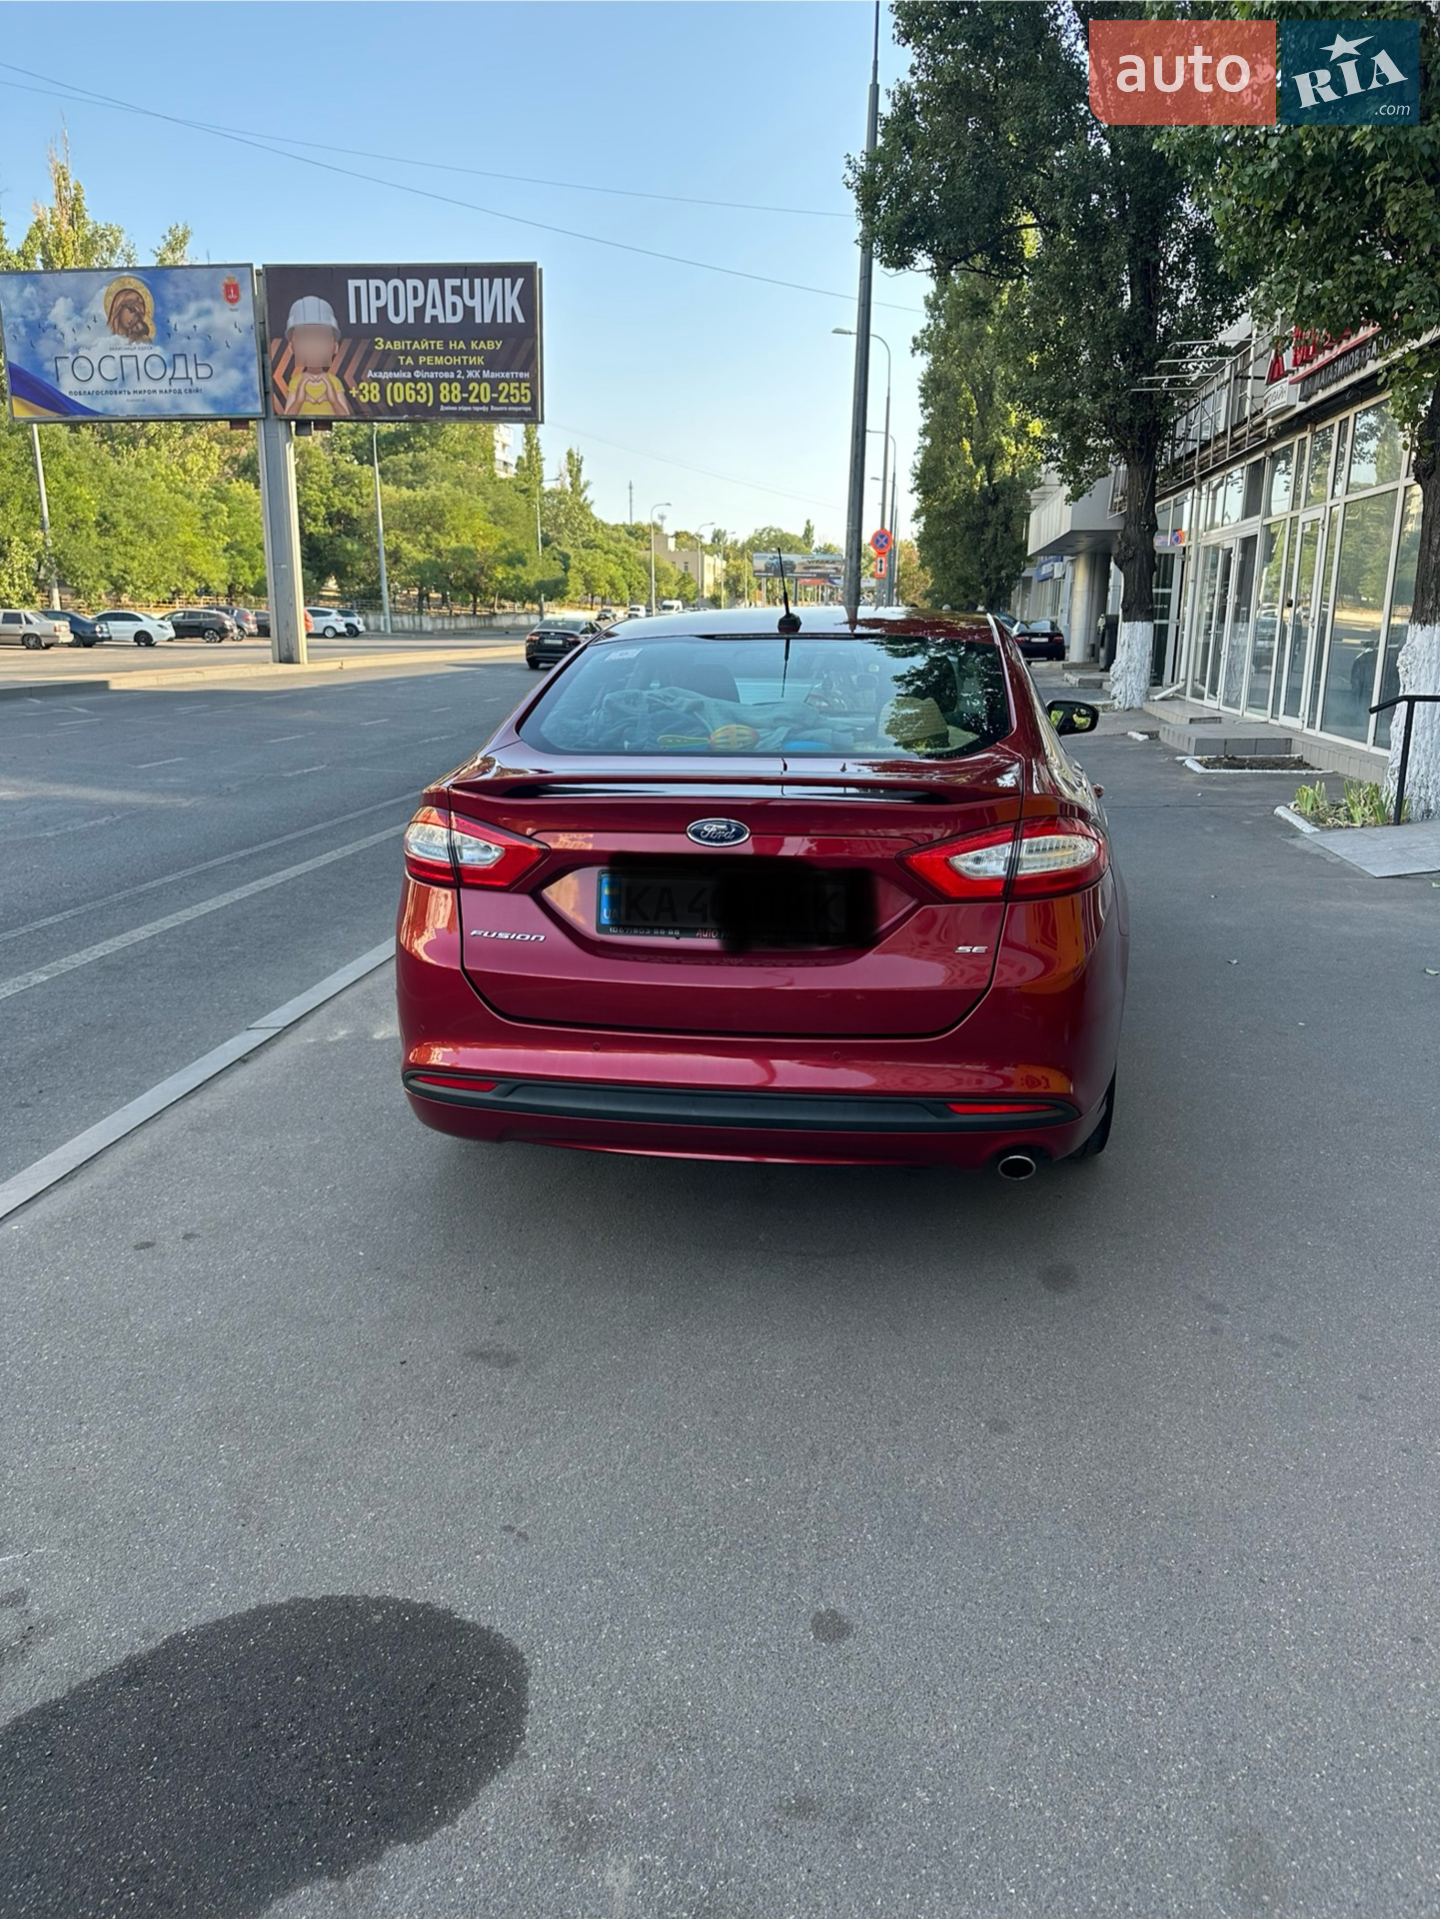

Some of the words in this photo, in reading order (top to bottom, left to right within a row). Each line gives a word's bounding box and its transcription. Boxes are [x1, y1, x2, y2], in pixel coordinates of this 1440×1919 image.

[348, 278, 526, 324] ПРОРАБЧИК
[54, 353, 214, 386] ГОСПОДЬ
[367, 370, 412, 380] Академіка
[413, 369, 455, 380] Філатова
[457, 370, 465, 380] 2,
[466, 370, 481, 379] ЖК
[482, 370, 530, 379] Манхеттен
[159, 388, 183, 396] НАРОД
[349, 382, 381, 403] +38
[386, 382, 434, 407] (063)
[439, 382, 532, 403] 88-20-255
[700, 823, 736, 840] Ford
[470, 929, 546, 942] FUSION
[955, 945, 988, 953] SE
